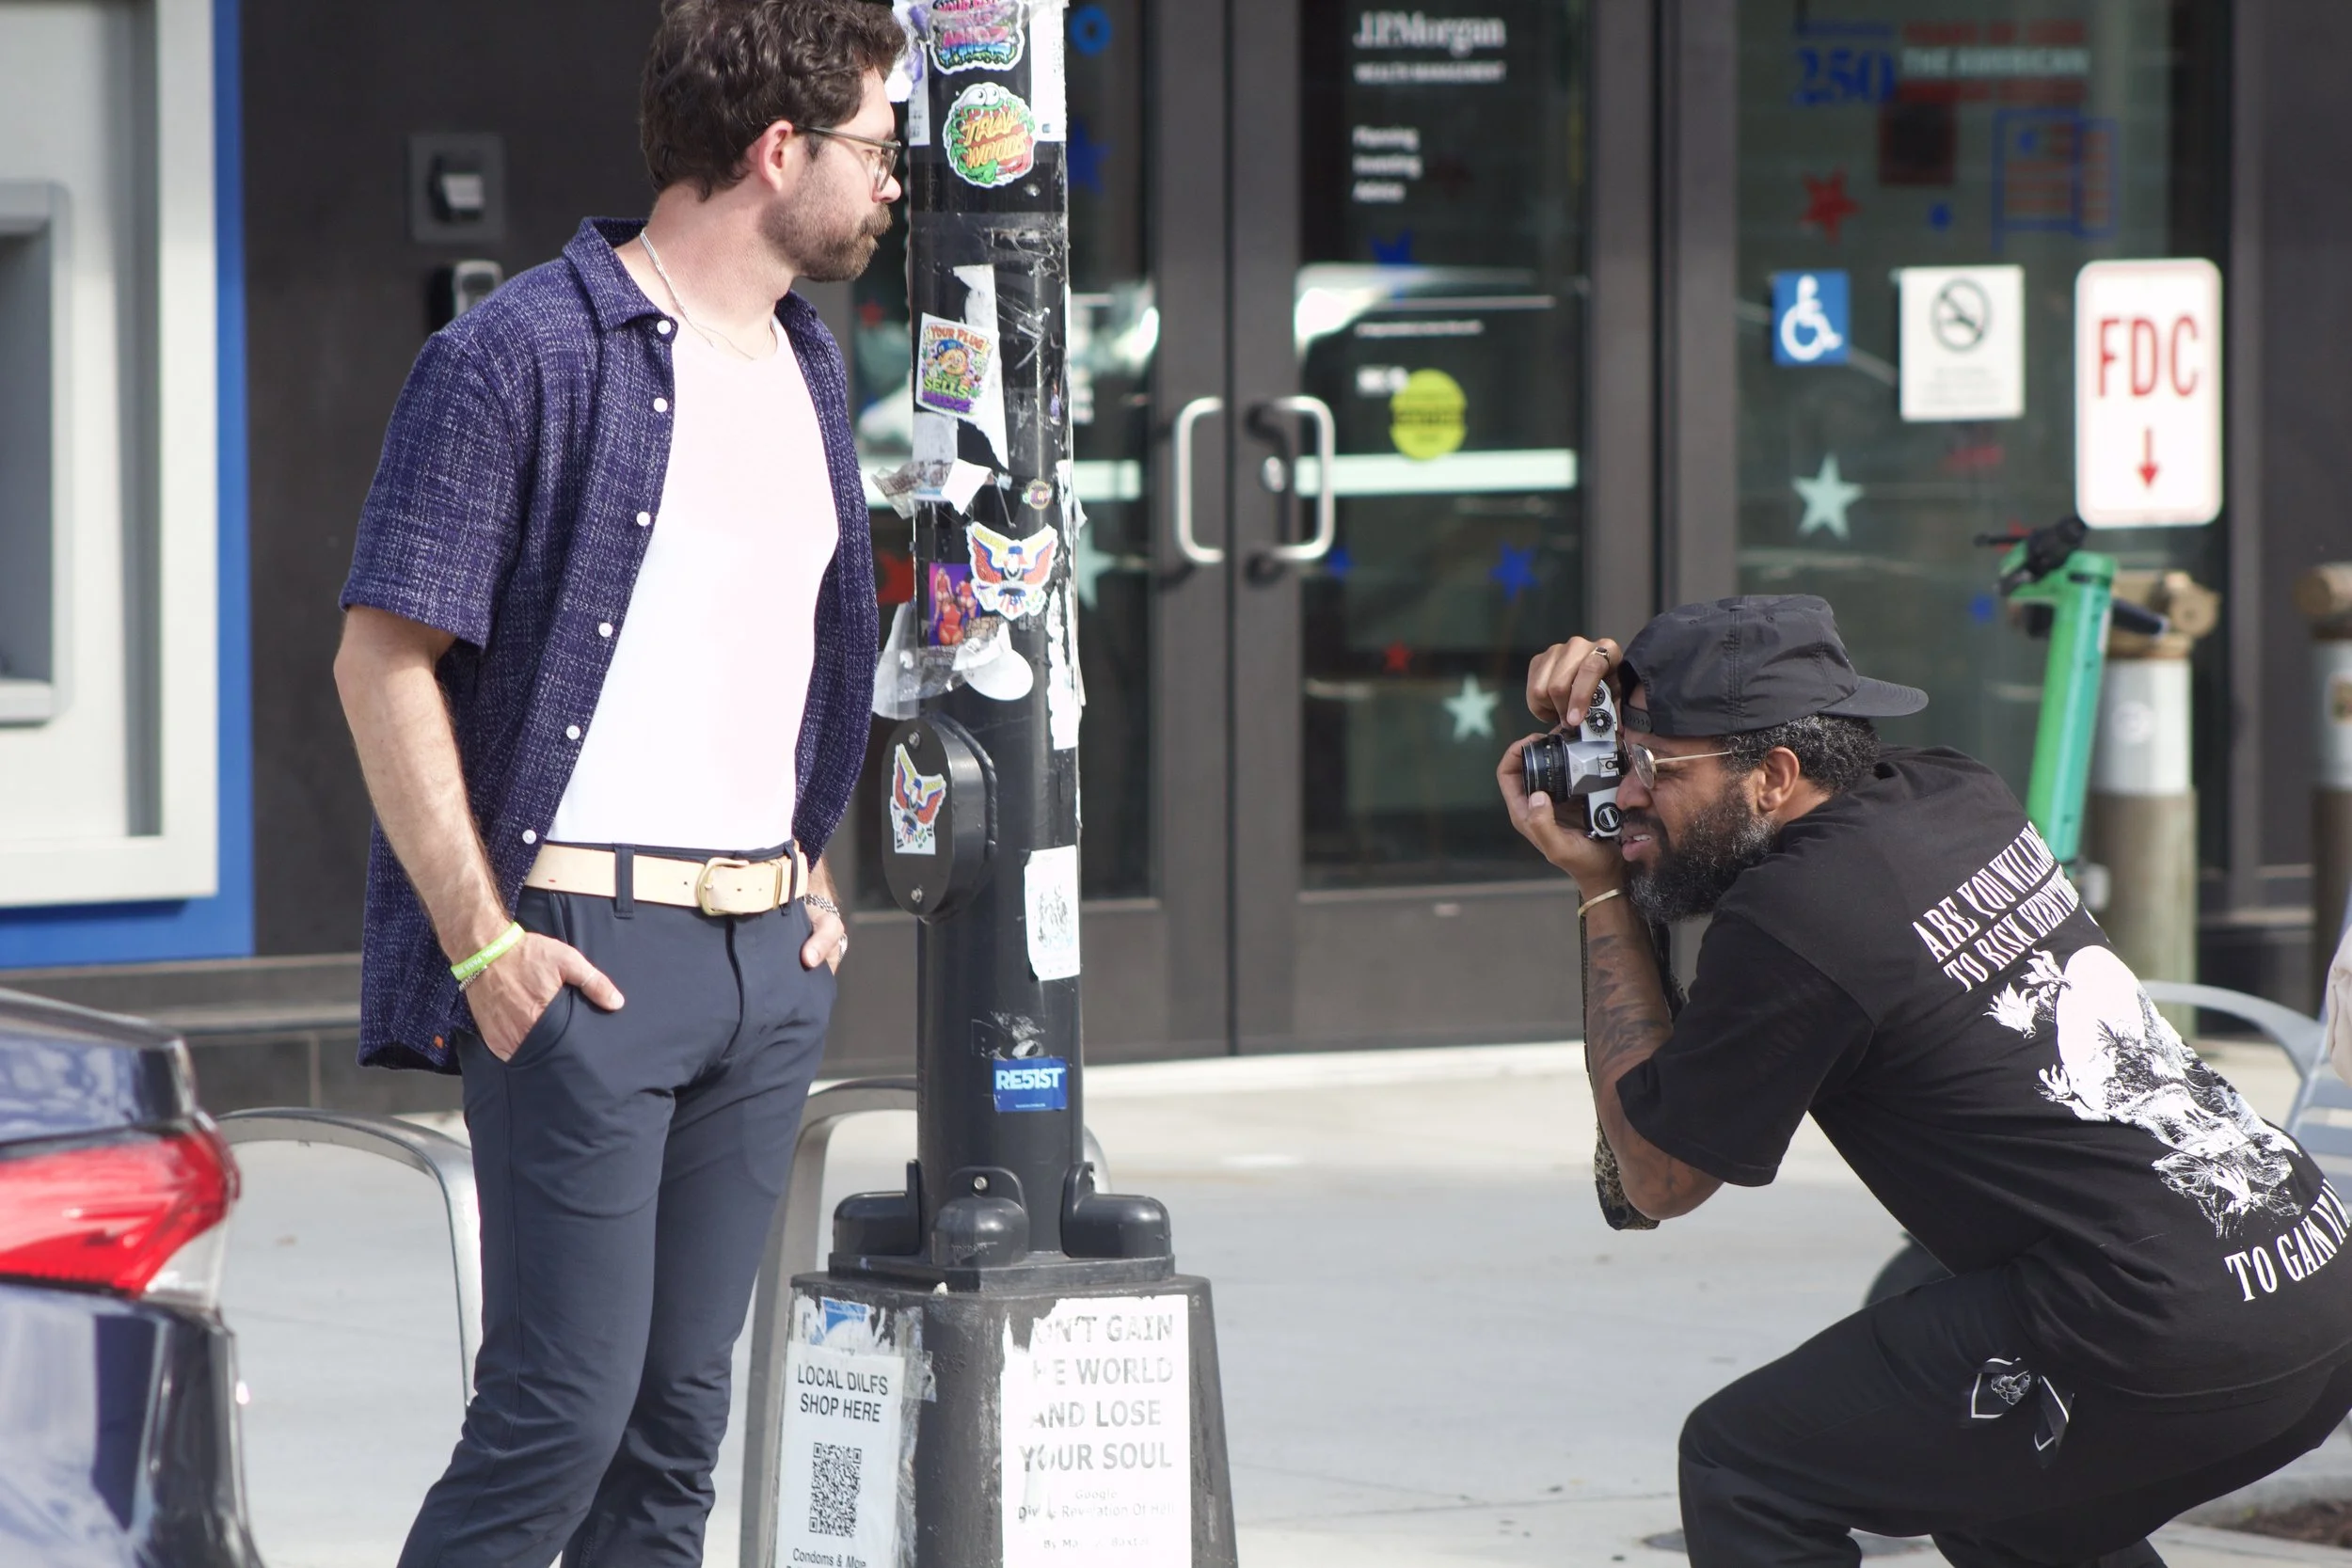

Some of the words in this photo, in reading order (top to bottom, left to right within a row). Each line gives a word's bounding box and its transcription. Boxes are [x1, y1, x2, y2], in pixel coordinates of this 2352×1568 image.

[2098, 315, 2200, 400] FDC
[924, 376, 969, 399] SELLS
[1913, 896, 1980, 963] ARE
[1957, 868, 2016, 920] YOU
[1943, 952, 1989, 992] TO
[1974, 913, 2038, 971] RISK
[2224, 1246, 2278, 1302] TO
[2277, 1215, 2337, 1282] GAIN
[1106, 1314, 1173, 1342] GAIN
[798, 1364, 843, 1390] LOCAL
[848, 1371, 888, 1396] DILFS
[1075, 1356, 1173, 1385] WORLD
[800, 1393, 839, 1418] SHOP
[843, 1402, 882, 1423] HERE
[1031, 1401, 1086, 1429] AND
[1095, 1399, 1162, 1428] LOSE
[1018, 1443, 1094, 1472] YOUR
[1103, 1441, 1172, 1470] SOUL
[792, 1547, 834, 1567] Condoms
[836, 1554, 843, 1567] &
